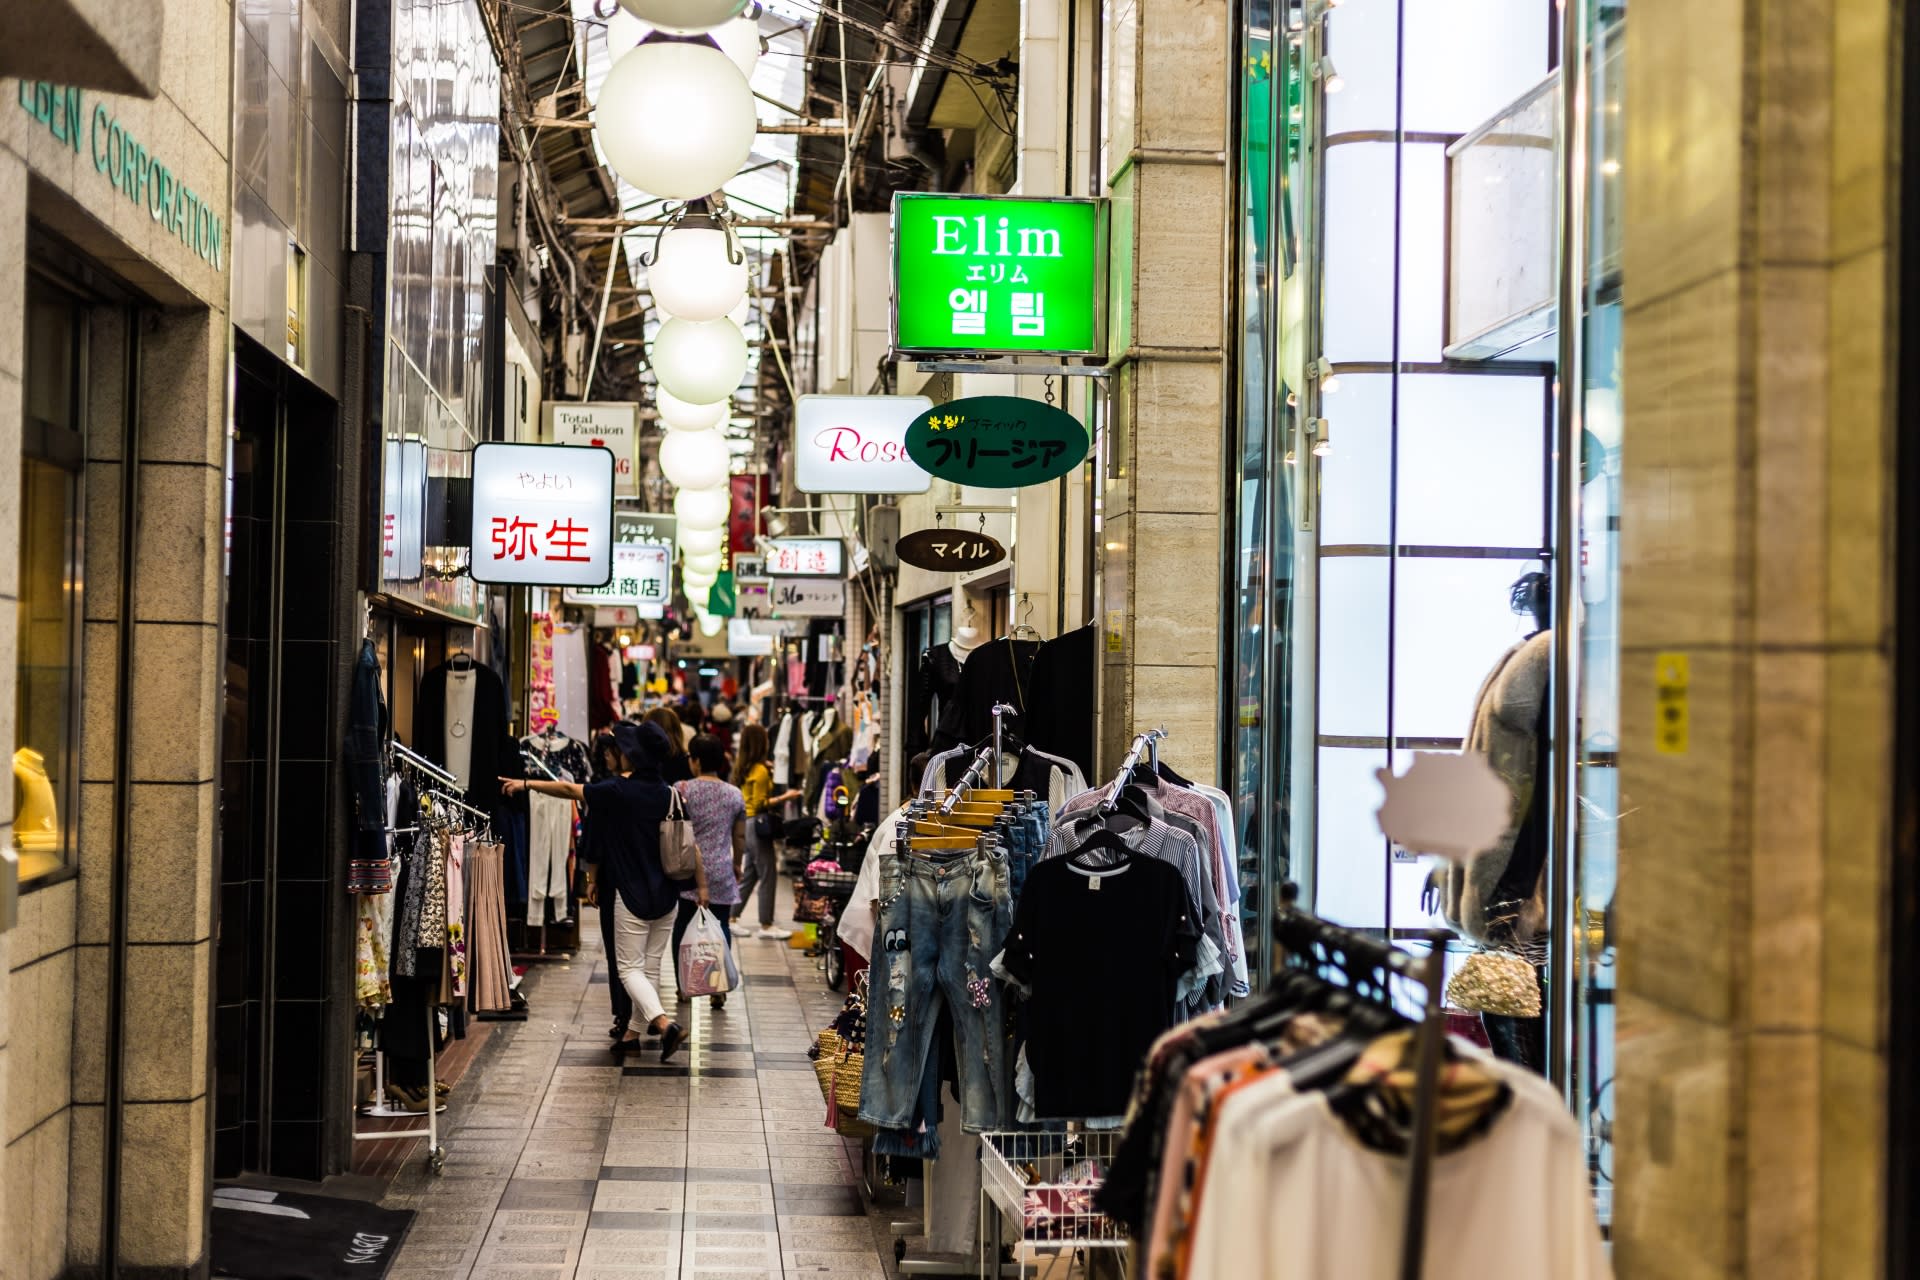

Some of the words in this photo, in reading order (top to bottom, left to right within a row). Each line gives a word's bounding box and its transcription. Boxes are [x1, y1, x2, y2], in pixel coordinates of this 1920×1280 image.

[92, 103, 222, 273] CORPORATION
[931, 214, 1063, 257] Elim
[965, 263, 1029, 284] エリム
[560, 413, 593, 424] Total
[573, 424, 624, 435] Fashion
[926, 437, 1067, 469] フリージア
[517, 471, 573, 490] やよい
[492, 515, 591, 563] 弥生
[779, 548, 828, 573] 創造
[931, 541, 990, 559] マイル
[576, 577, 661, 597] 商店
